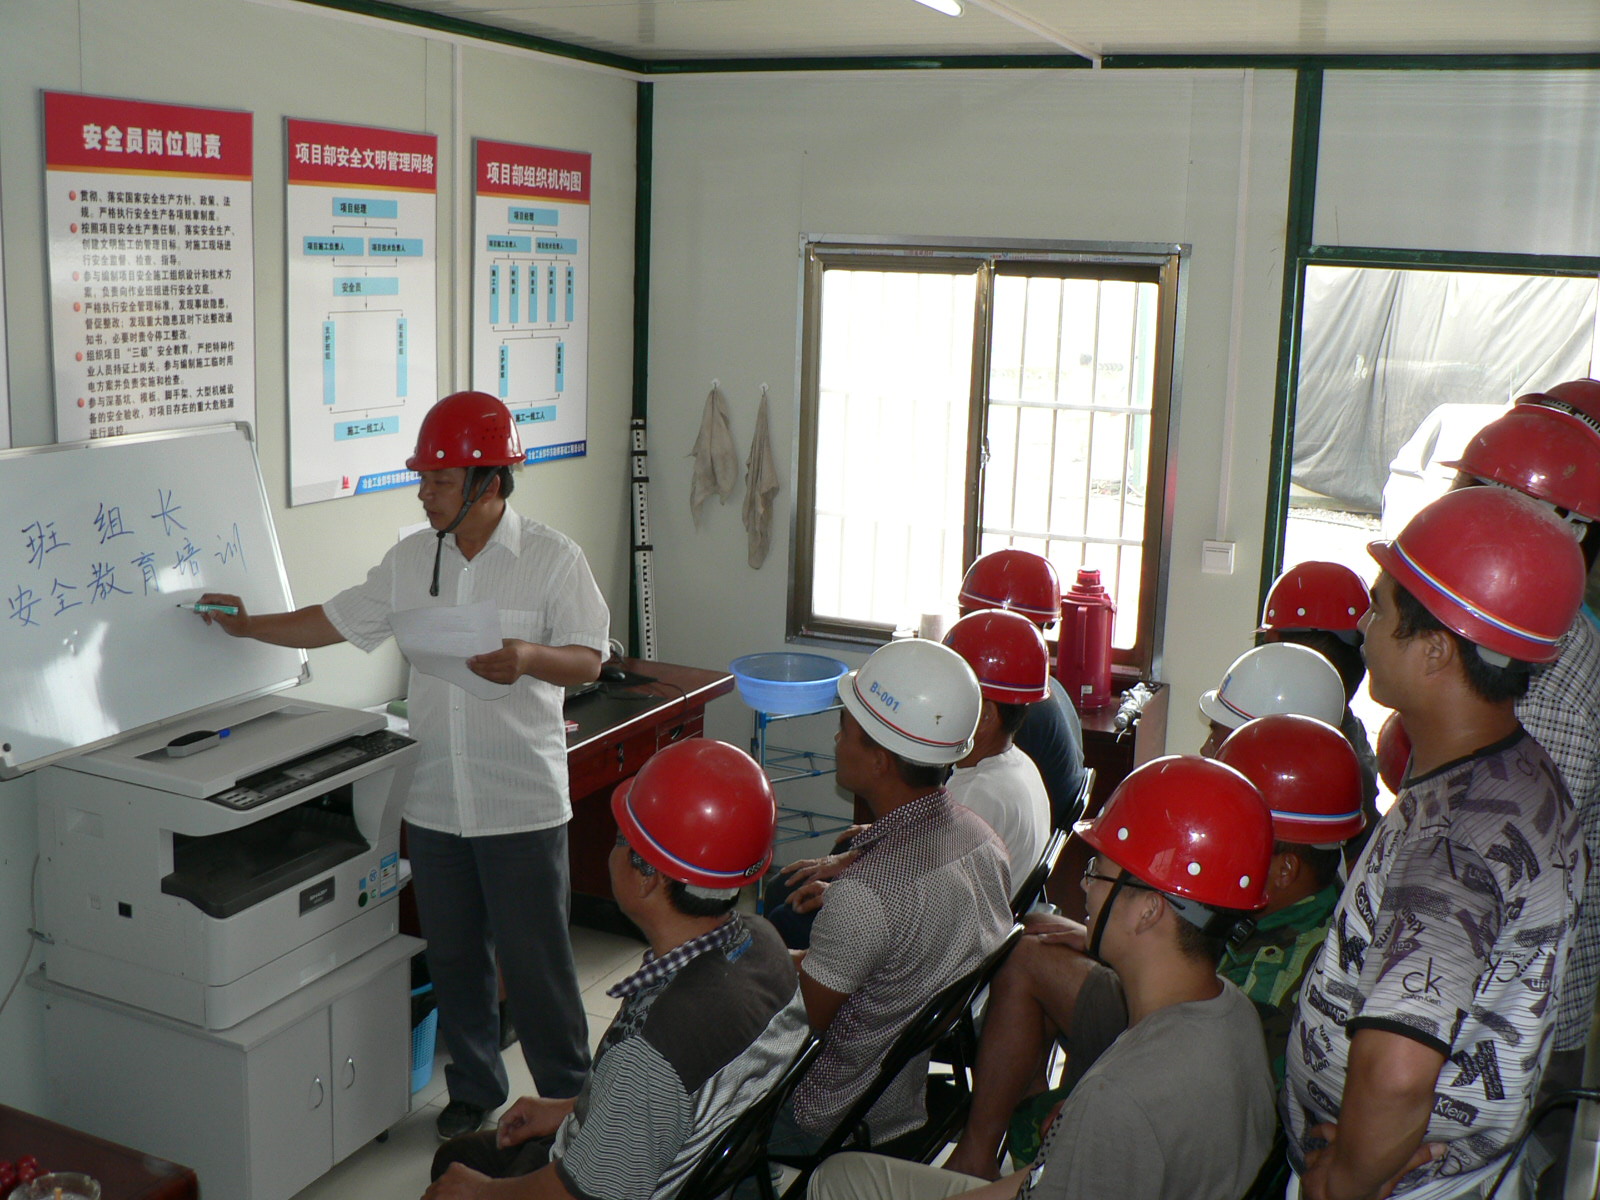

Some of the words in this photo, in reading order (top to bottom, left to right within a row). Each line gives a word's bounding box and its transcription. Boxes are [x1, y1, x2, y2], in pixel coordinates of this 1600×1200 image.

[82, 123, 222, 160] 安全员岗位职责
[295, 142, 435, 175] 项目部安全文明管理网络
[486, 161, 582, 192] 项目部组织机构图
[339, 202, 368, 215] 项目经理
[514, 210, 534, 222] 项目经理
[341, 281, 362, 293] 安全员
[21, 488, 187, 570] 班组长
[8, 522, 248, 627] 安全教育培训
[869, 681, 901, 711] B-001
[1402, 957, 1444, 998] ck
[1435, 1097, 1471, 1124] Klein
